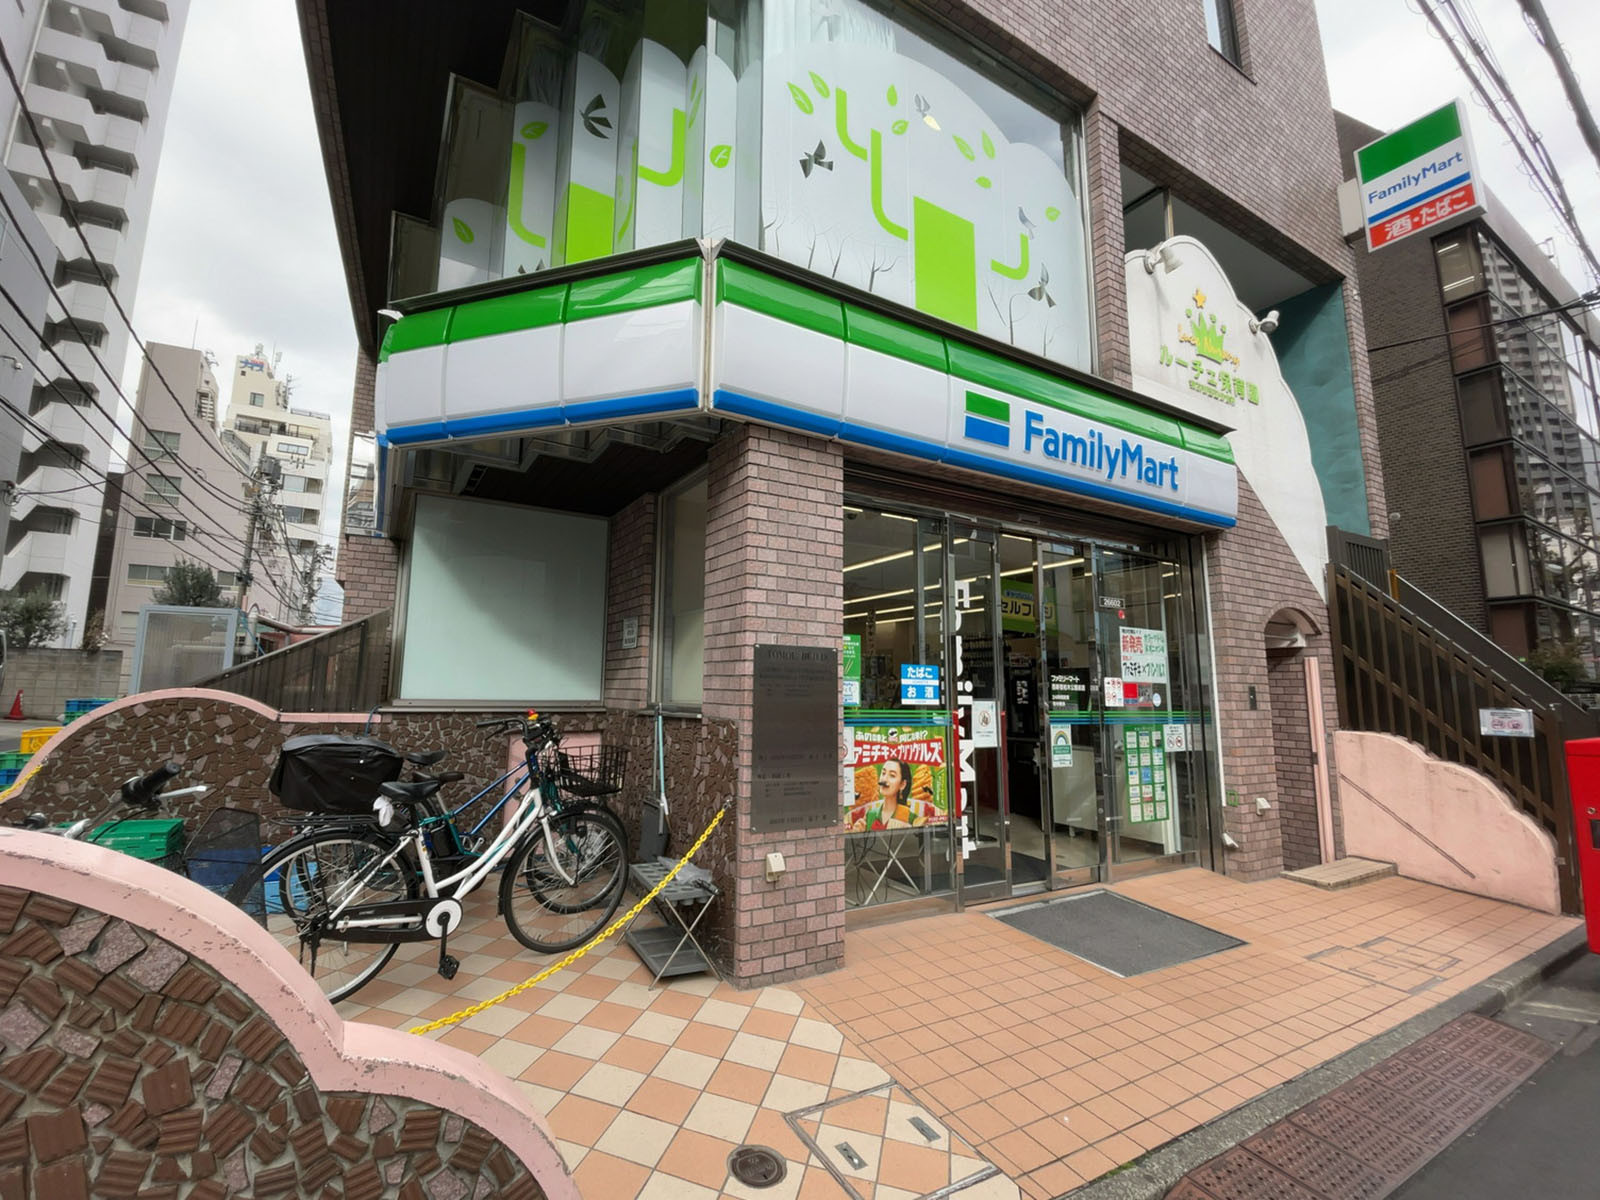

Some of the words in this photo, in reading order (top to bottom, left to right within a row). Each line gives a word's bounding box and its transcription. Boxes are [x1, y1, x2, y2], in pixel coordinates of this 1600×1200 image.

[1368, 152, 1463, 204] FamilyMart
[1385, 191, 1468, 240] 酒・たばこ
[1024, 409, 1178, 491] FamilyMart
[1104, 598, 1120, 607] 26602
[1122, 635, 1143, 653] 新発売
[907, 667, 934, 678] たばこ
